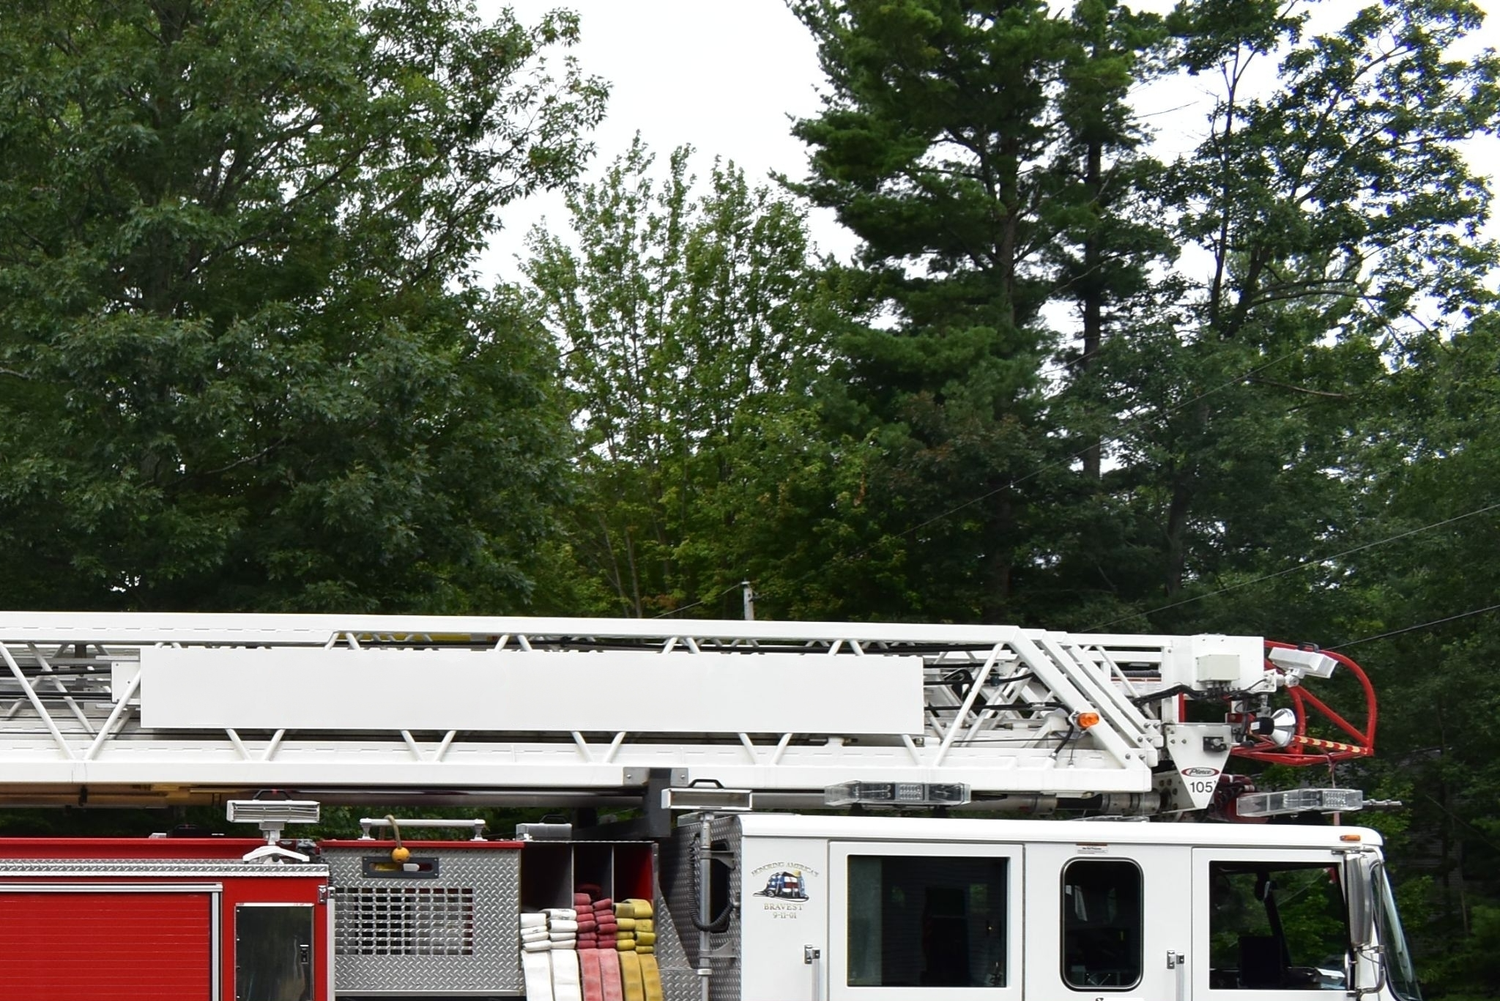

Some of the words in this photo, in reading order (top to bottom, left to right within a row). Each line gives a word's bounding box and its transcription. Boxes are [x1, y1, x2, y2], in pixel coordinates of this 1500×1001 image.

[1189, 768, 1212, 776] Pierce
[751, 861, 785, 877] HONORING
[764, 903, 804, 911] BRAVEST
[772, 911, 797, 919] 9-11-01
